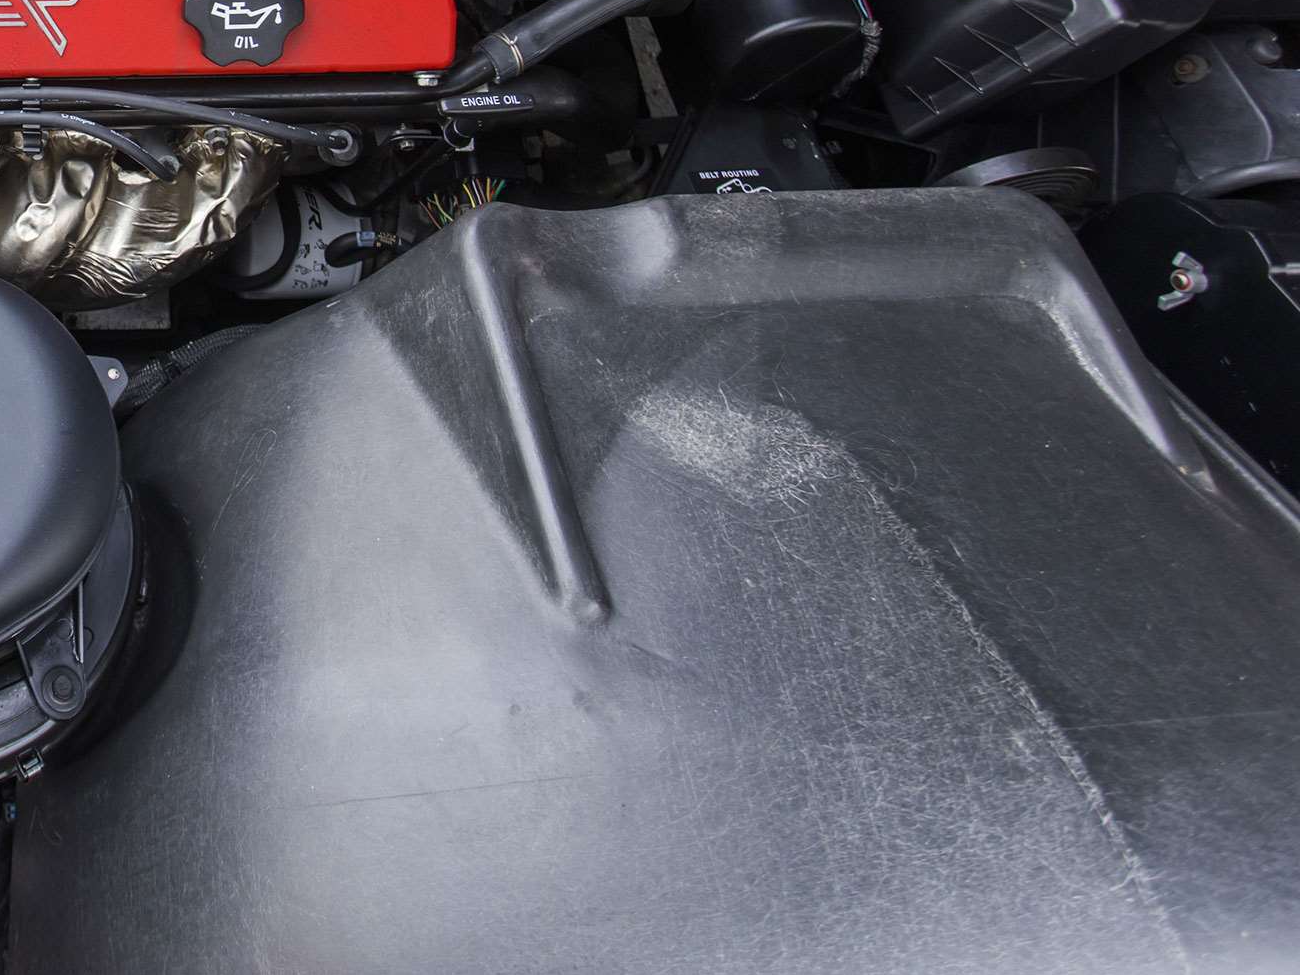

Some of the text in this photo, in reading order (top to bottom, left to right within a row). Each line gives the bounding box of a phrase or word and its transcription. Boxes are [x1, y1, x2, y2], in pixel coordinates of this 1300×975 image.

[234, 35, 259, 49] OIL
[460, 95, 521, 107] ENGINE OIL
[699, 169, 760, 179] BELT ROUTING
